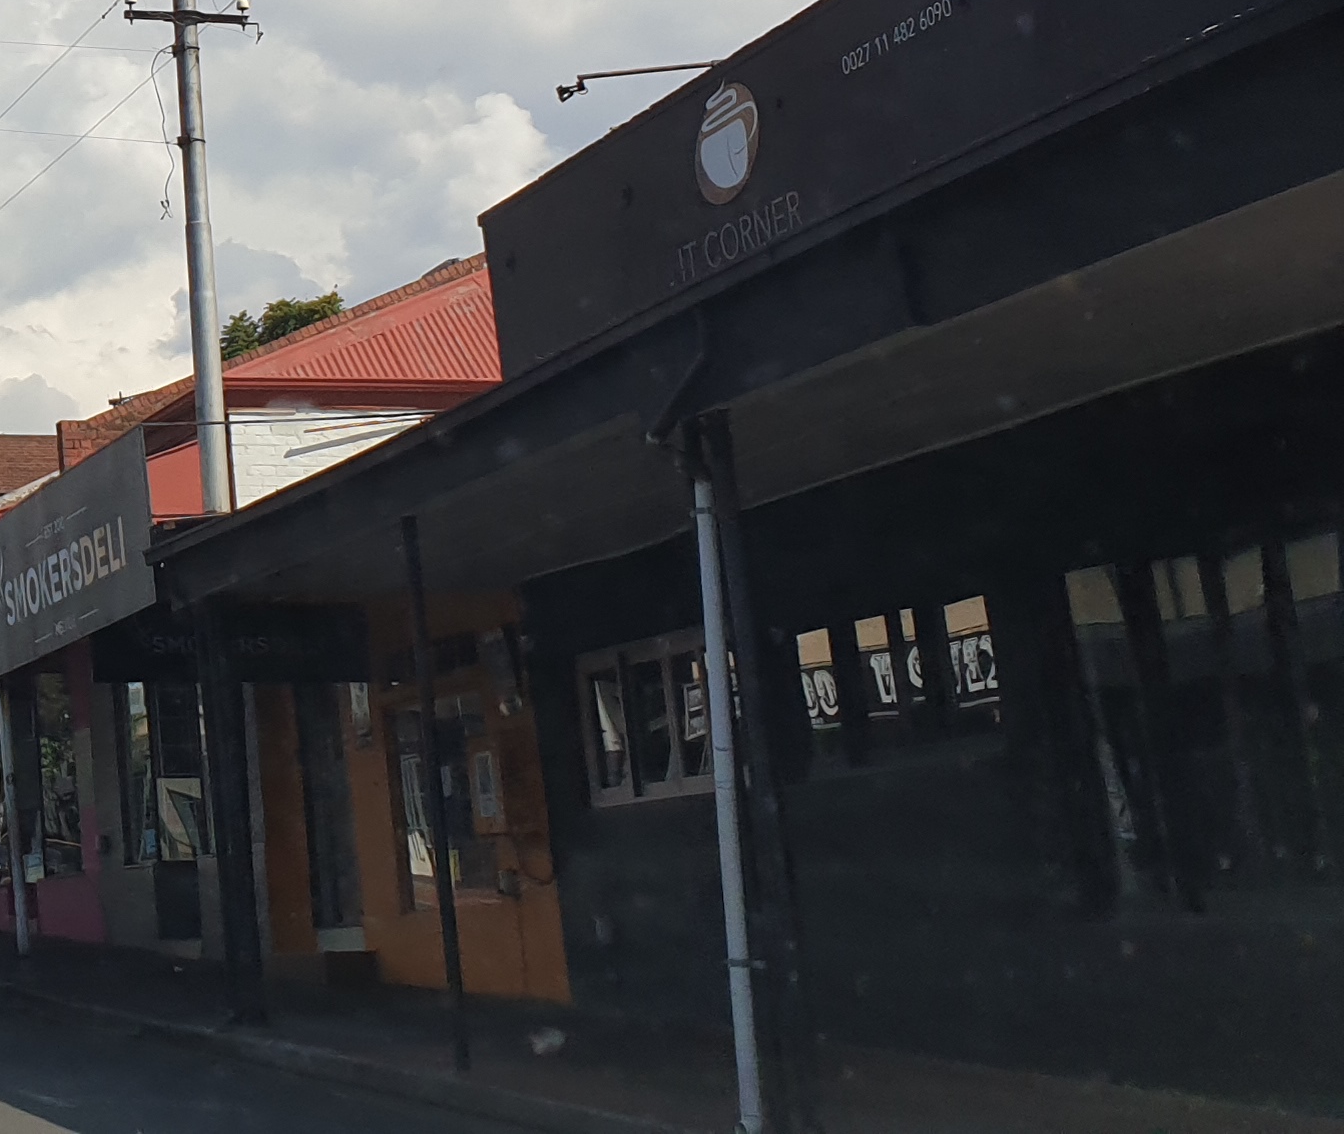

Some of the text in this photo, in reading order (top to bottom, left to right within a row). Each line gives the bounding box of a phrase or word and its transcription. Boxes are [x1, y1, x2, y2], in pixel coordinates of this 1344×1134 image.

[841, 41, 871, 75] 0027
[874, 33, 889, 56] 11
[893, 17, 917, 45] 482
[703, 190, 803, 270] CORNER
[4, 515, 127, 626] SMOKERSDELI
